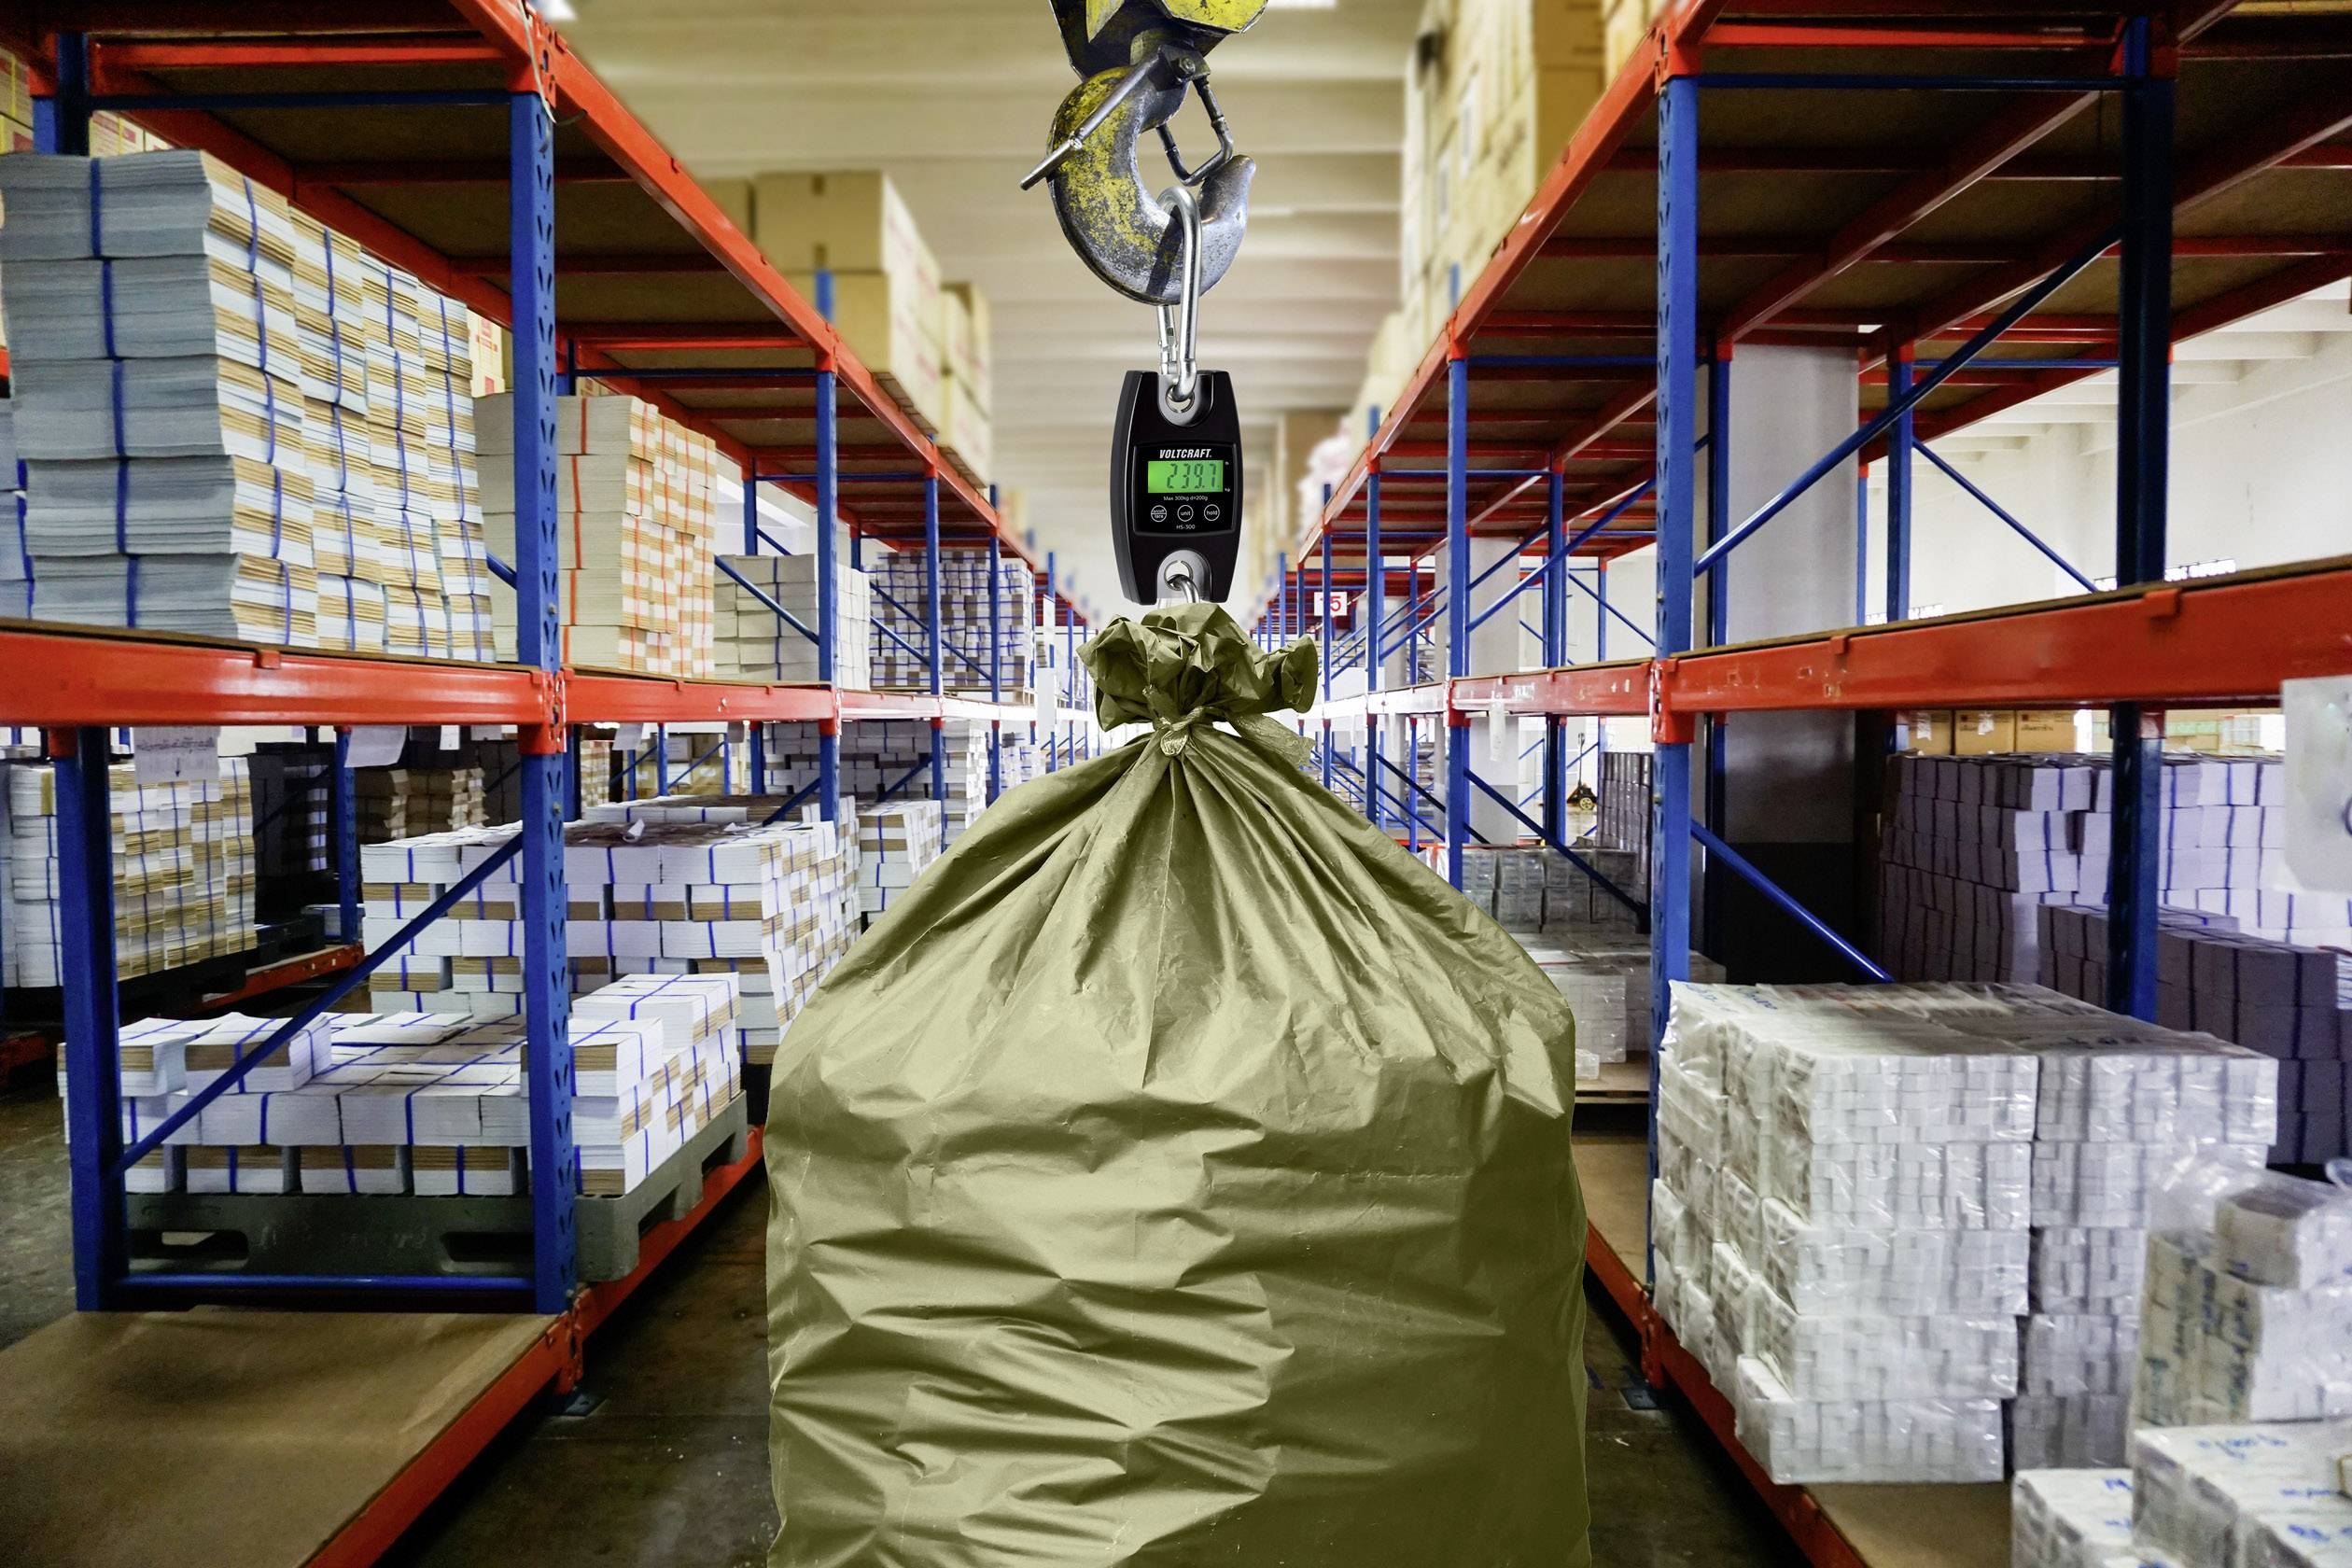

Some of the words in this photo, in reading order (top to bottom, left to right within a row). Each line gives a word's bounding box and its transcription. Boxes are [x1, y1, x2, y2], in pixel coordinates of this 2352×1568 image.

[1159, 449, 1211, 458] VOLTCRAFT
[1167, 463, 1216, 489] 239.7
[1320, 595, 1341, 611] 5
